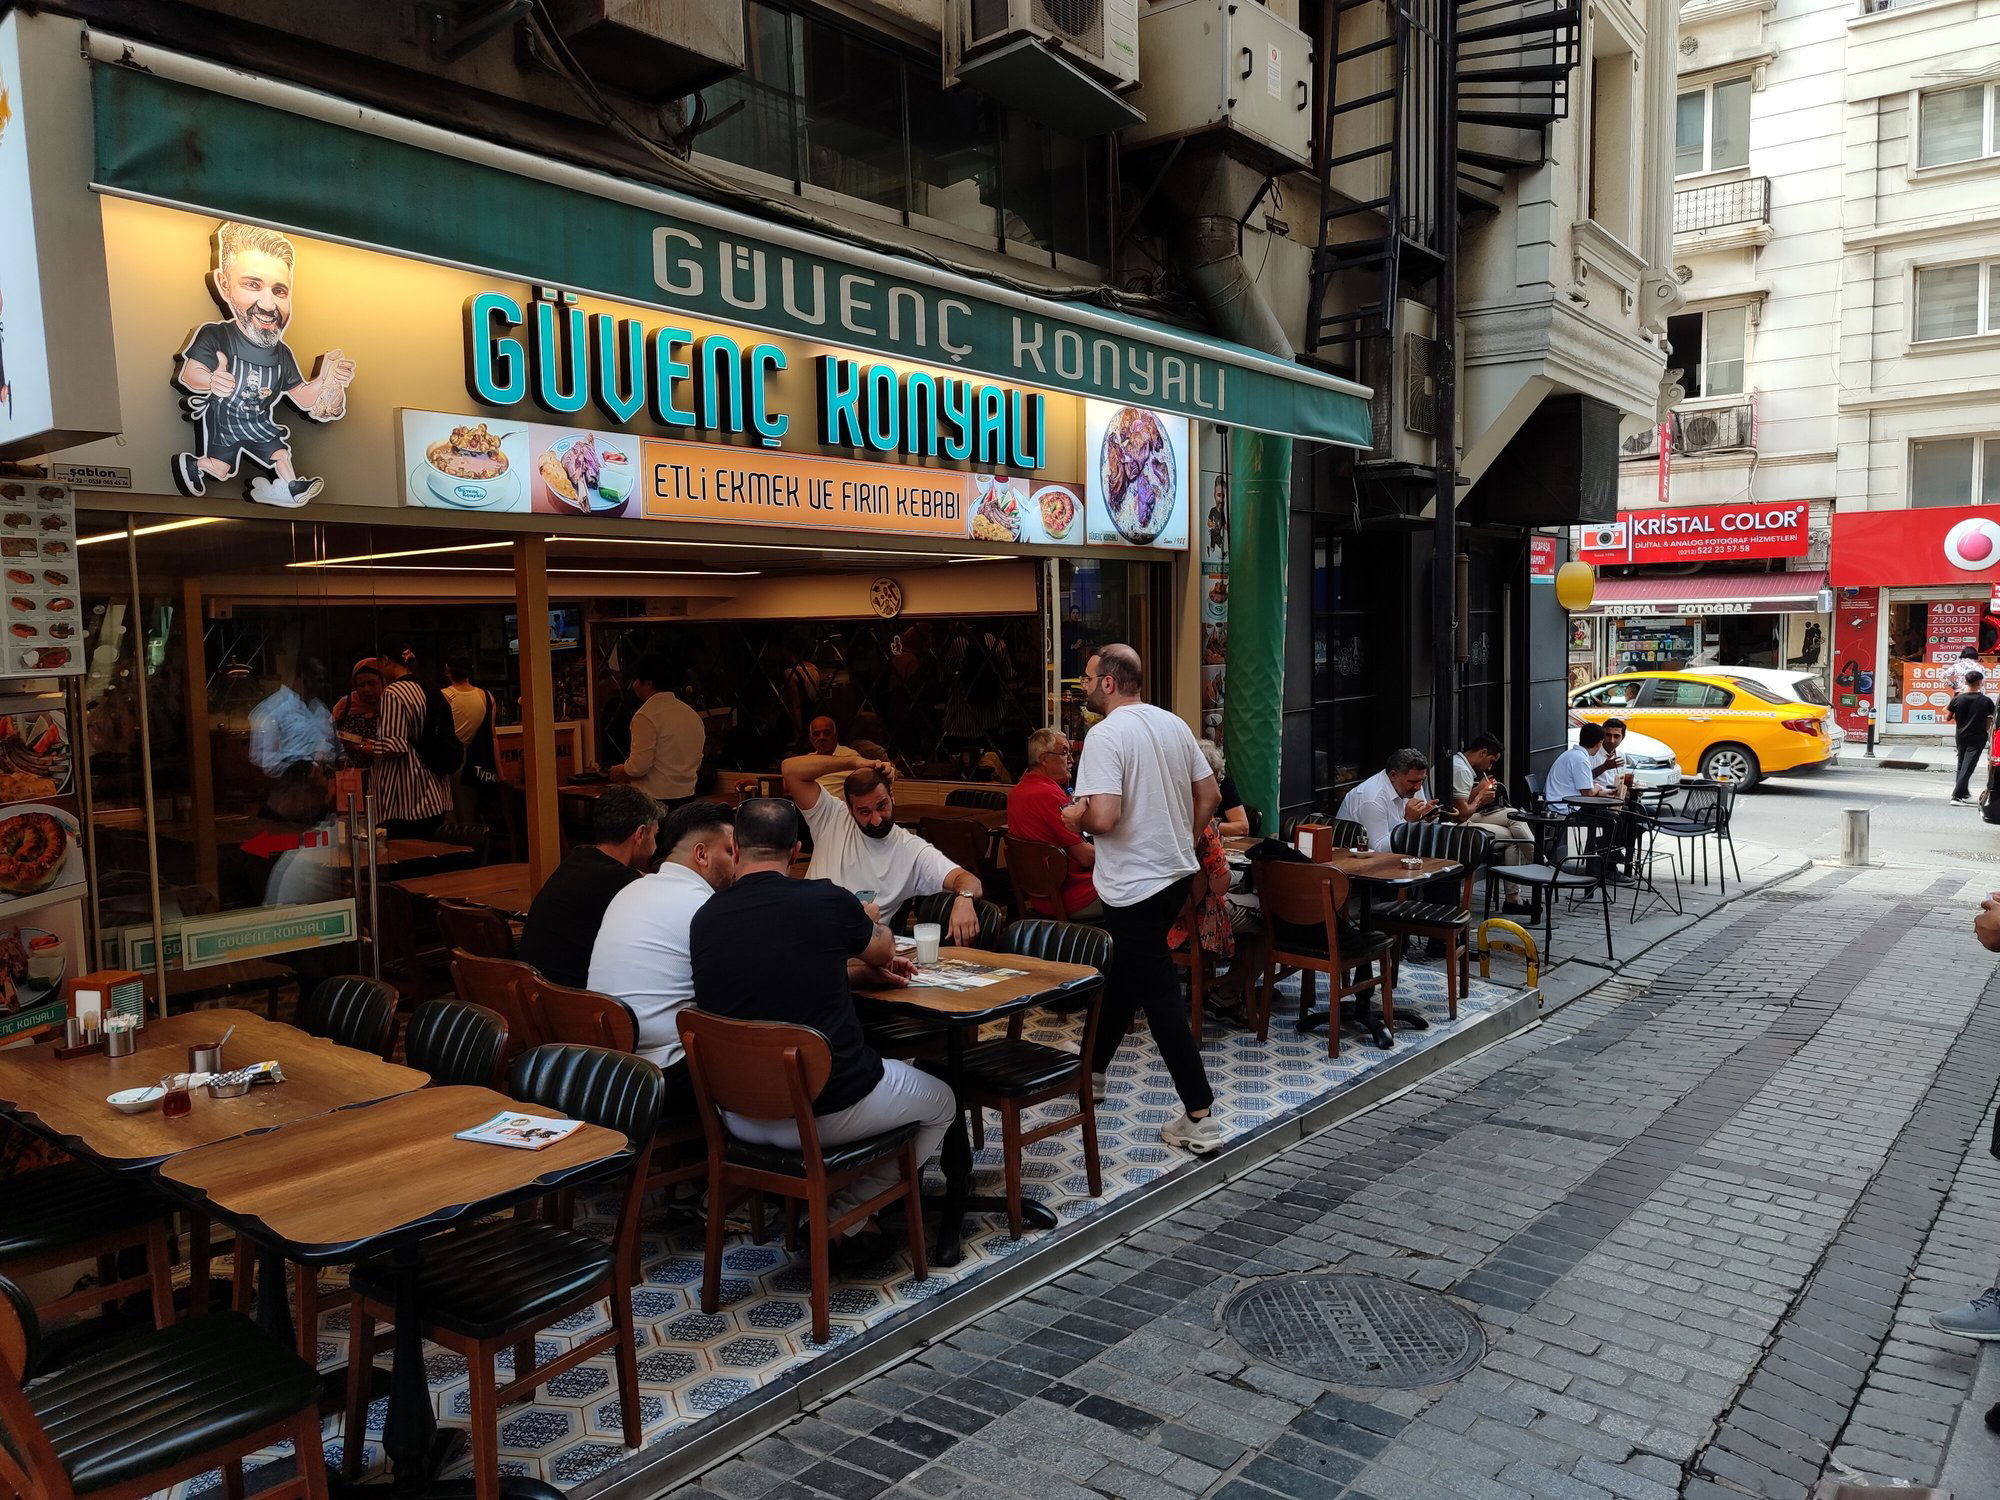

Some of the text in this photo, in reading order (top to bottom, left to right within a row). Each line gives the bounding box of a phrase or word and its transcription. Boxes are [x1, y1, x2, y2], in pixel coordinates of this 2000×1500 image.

[1013, 317, 1225, 411] KONYALI
[468, 287, 1046, 470] GÜVENÇ KONYALI
[69, 467, 116, 478] şablon
[715, 469, 801, 508] EKMEK
[842, 481, 890, 515] FIRIN
[896, 487, 961, 520] KEBABI
[1634, 510, 1797, 536] KRİSTAL COLOR
[1669, 539, 1704, 547] ANALOG
[1705, 536, 1749, 545] FOTOĞRAF
[1750, 533, 1798, 543] HİZMETLERİ
[1726, 545, 1750, 553] 57-58
[1603, 604, 1660, 615] KRİSTAL
[1932, 603, 1976, 614] 40 GB
[1932, 616, 1958, 624] 2500
[1932, 626, 1974, 634] 250 SMS
[1936, 653, 1958, 662] 599
[1913, 667, 1922, 679] 8
[1911, 681, 1932, 689] 1000
[1986, 682, 1999, 690] DK
